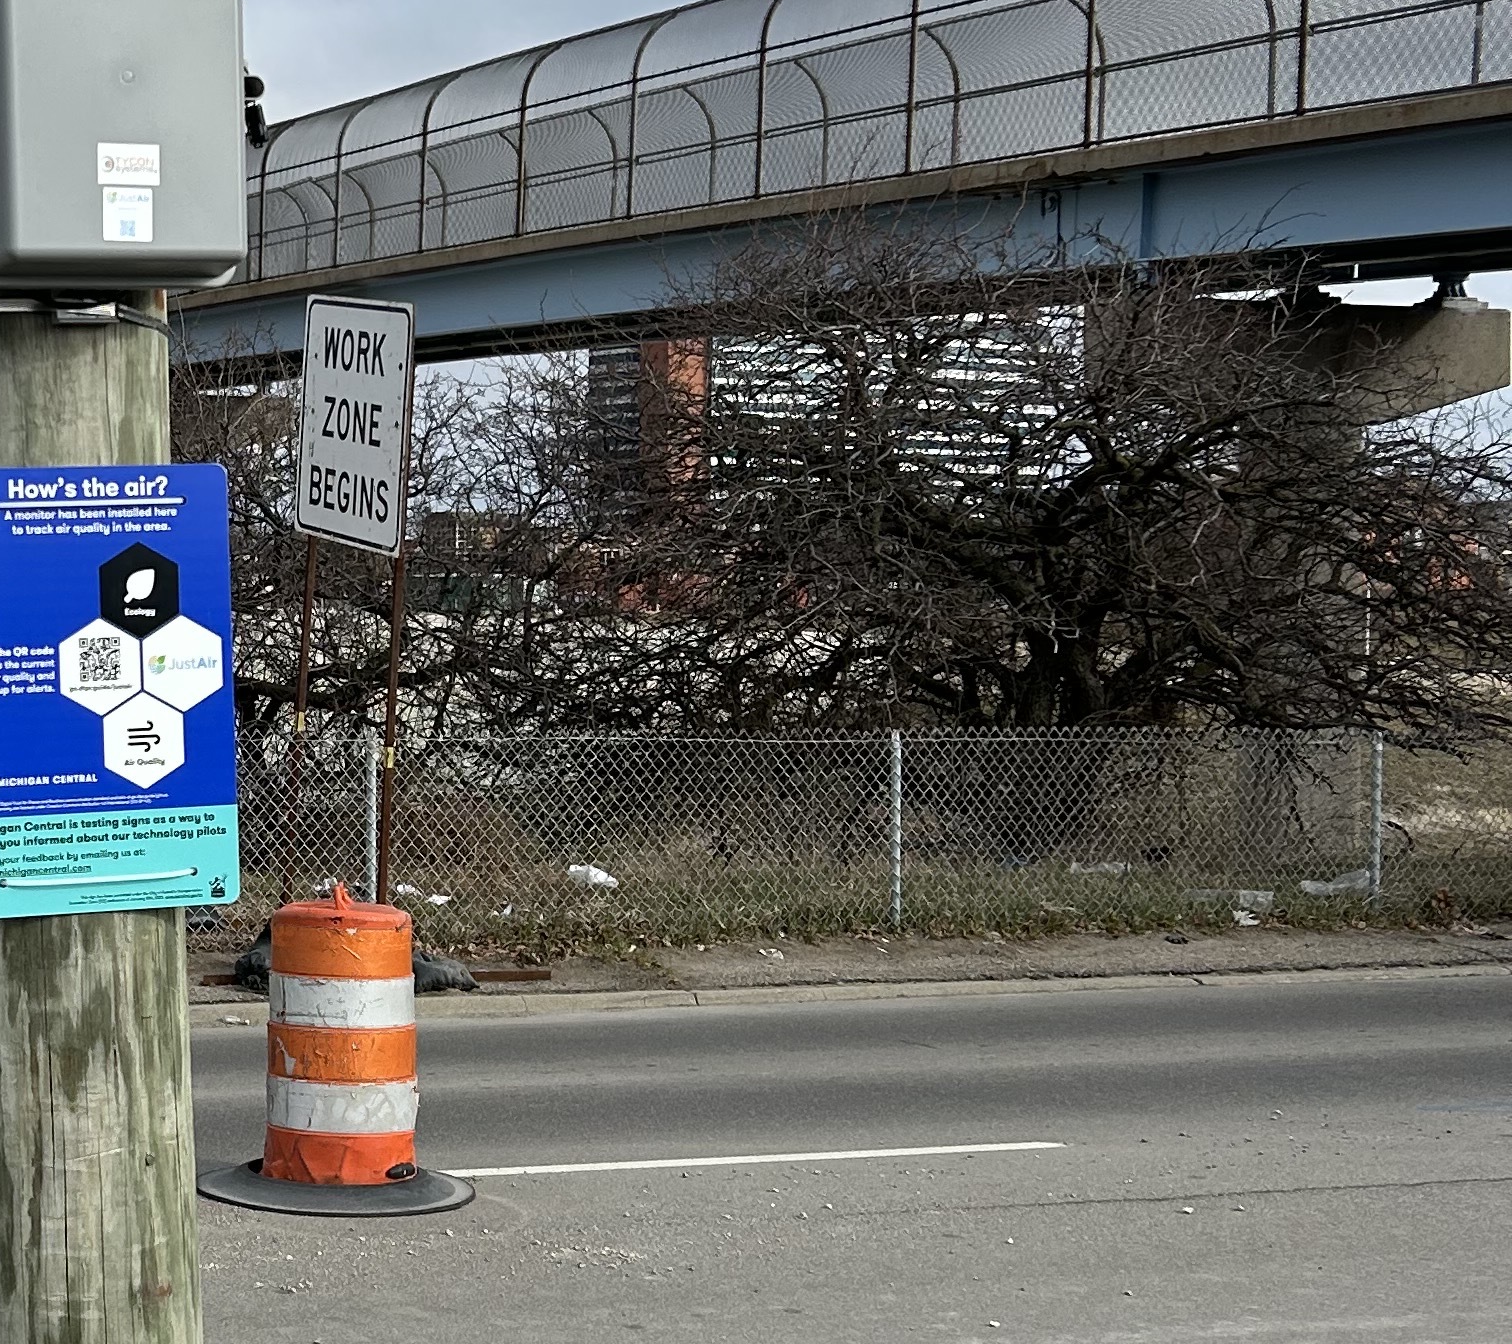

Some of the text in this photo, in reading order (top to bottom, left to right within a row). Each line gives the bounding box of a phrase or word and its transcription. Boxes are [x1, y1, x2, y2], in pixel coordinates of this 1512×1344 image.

[116, 157, 155, 167] TYCON
[324, 326, 386, 377] WORK
[322, 395, 382, 447] ZONE
[7, 475, 168, 499] How's the air?
[309, 464, 389, 523] BEGINS
[4, 507, 178, 520] A monitor has been installed here
[12, 522, 171, 536] to track air quality in the area.
[124, 607, 156, 617] Ecology
[13, 646, 28, 657] QR
[30, 645, 55, 656] code
[4, 660, 20, 669] the
[21, 659, 55, 669] current
[168, 657, 218, 670] JustAir
[2, 671, 36, 684] quality
[36, 670, 56, 680] and
[11, 685, 26, 694] for
[26, 684, 56, 693] alerts.
[52, 773, 98, 784] CENTRAL
[24, 820, 67, 831] Central
[69, 819, 78, 829] is
[81, 817, 119, 829] testing
[122, 816, 151, 827] signs
[178, 815, 201, 824] way
[203, 813, 215, 822] to
[0, 841, 21, 850] you
[23, 834, 74, 846] informed
[76, 833, 109, 843] about
[111, 833, 130, 841] our
[132, 828, 194, 840] technology
[196, 826, 227, 838] pilots
[0, 857, 20, 866] your
[22, 852, 64, 862] feedback
[67, 852, 79, 861] by
[80, 849, 119, 860] emailing
